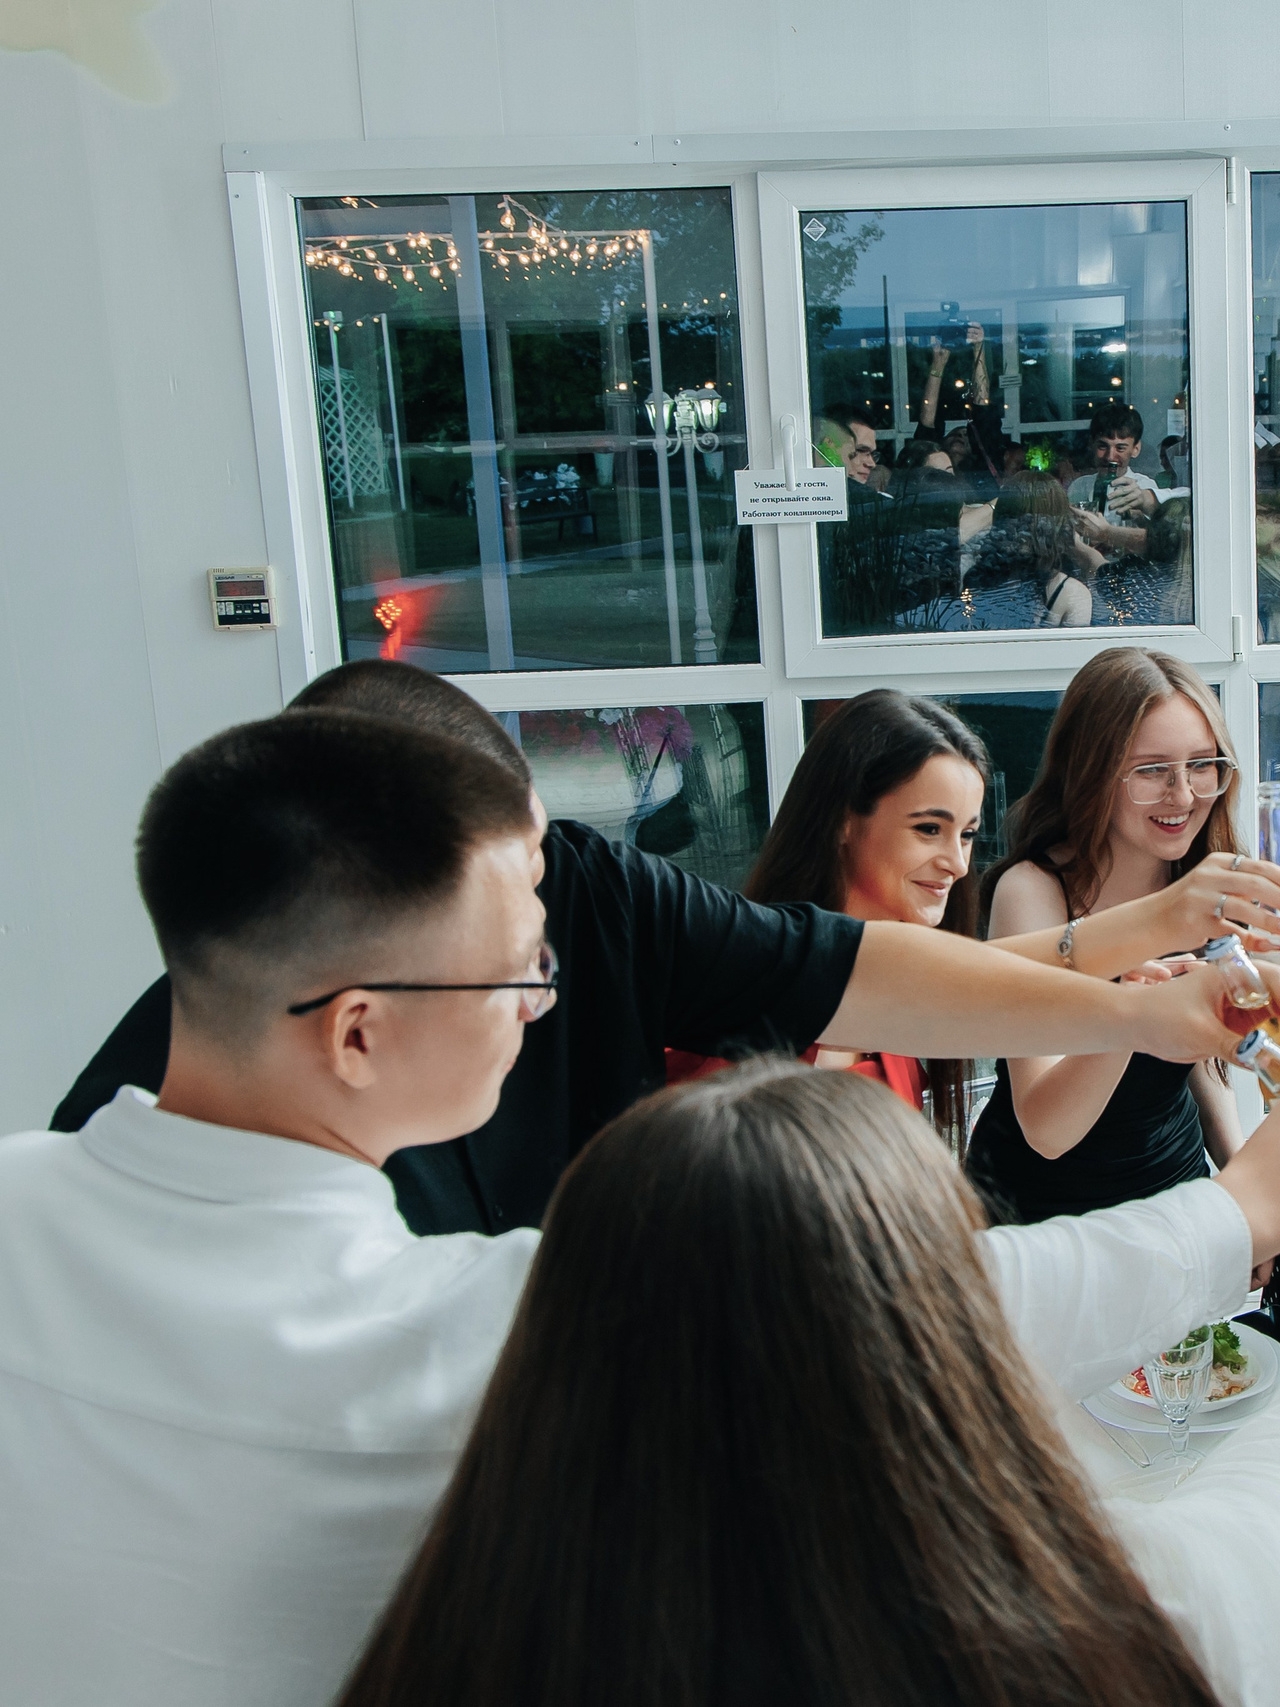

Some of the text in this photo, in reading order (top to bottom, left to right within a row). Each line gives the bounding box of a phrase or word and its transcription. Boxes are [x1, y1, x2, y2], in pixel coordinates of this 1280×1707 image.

[754, 481, 802, 489] Уважаее
[762, 495, 810, 505] открывайте
[784, 509, 843, 517] кондиционеры
